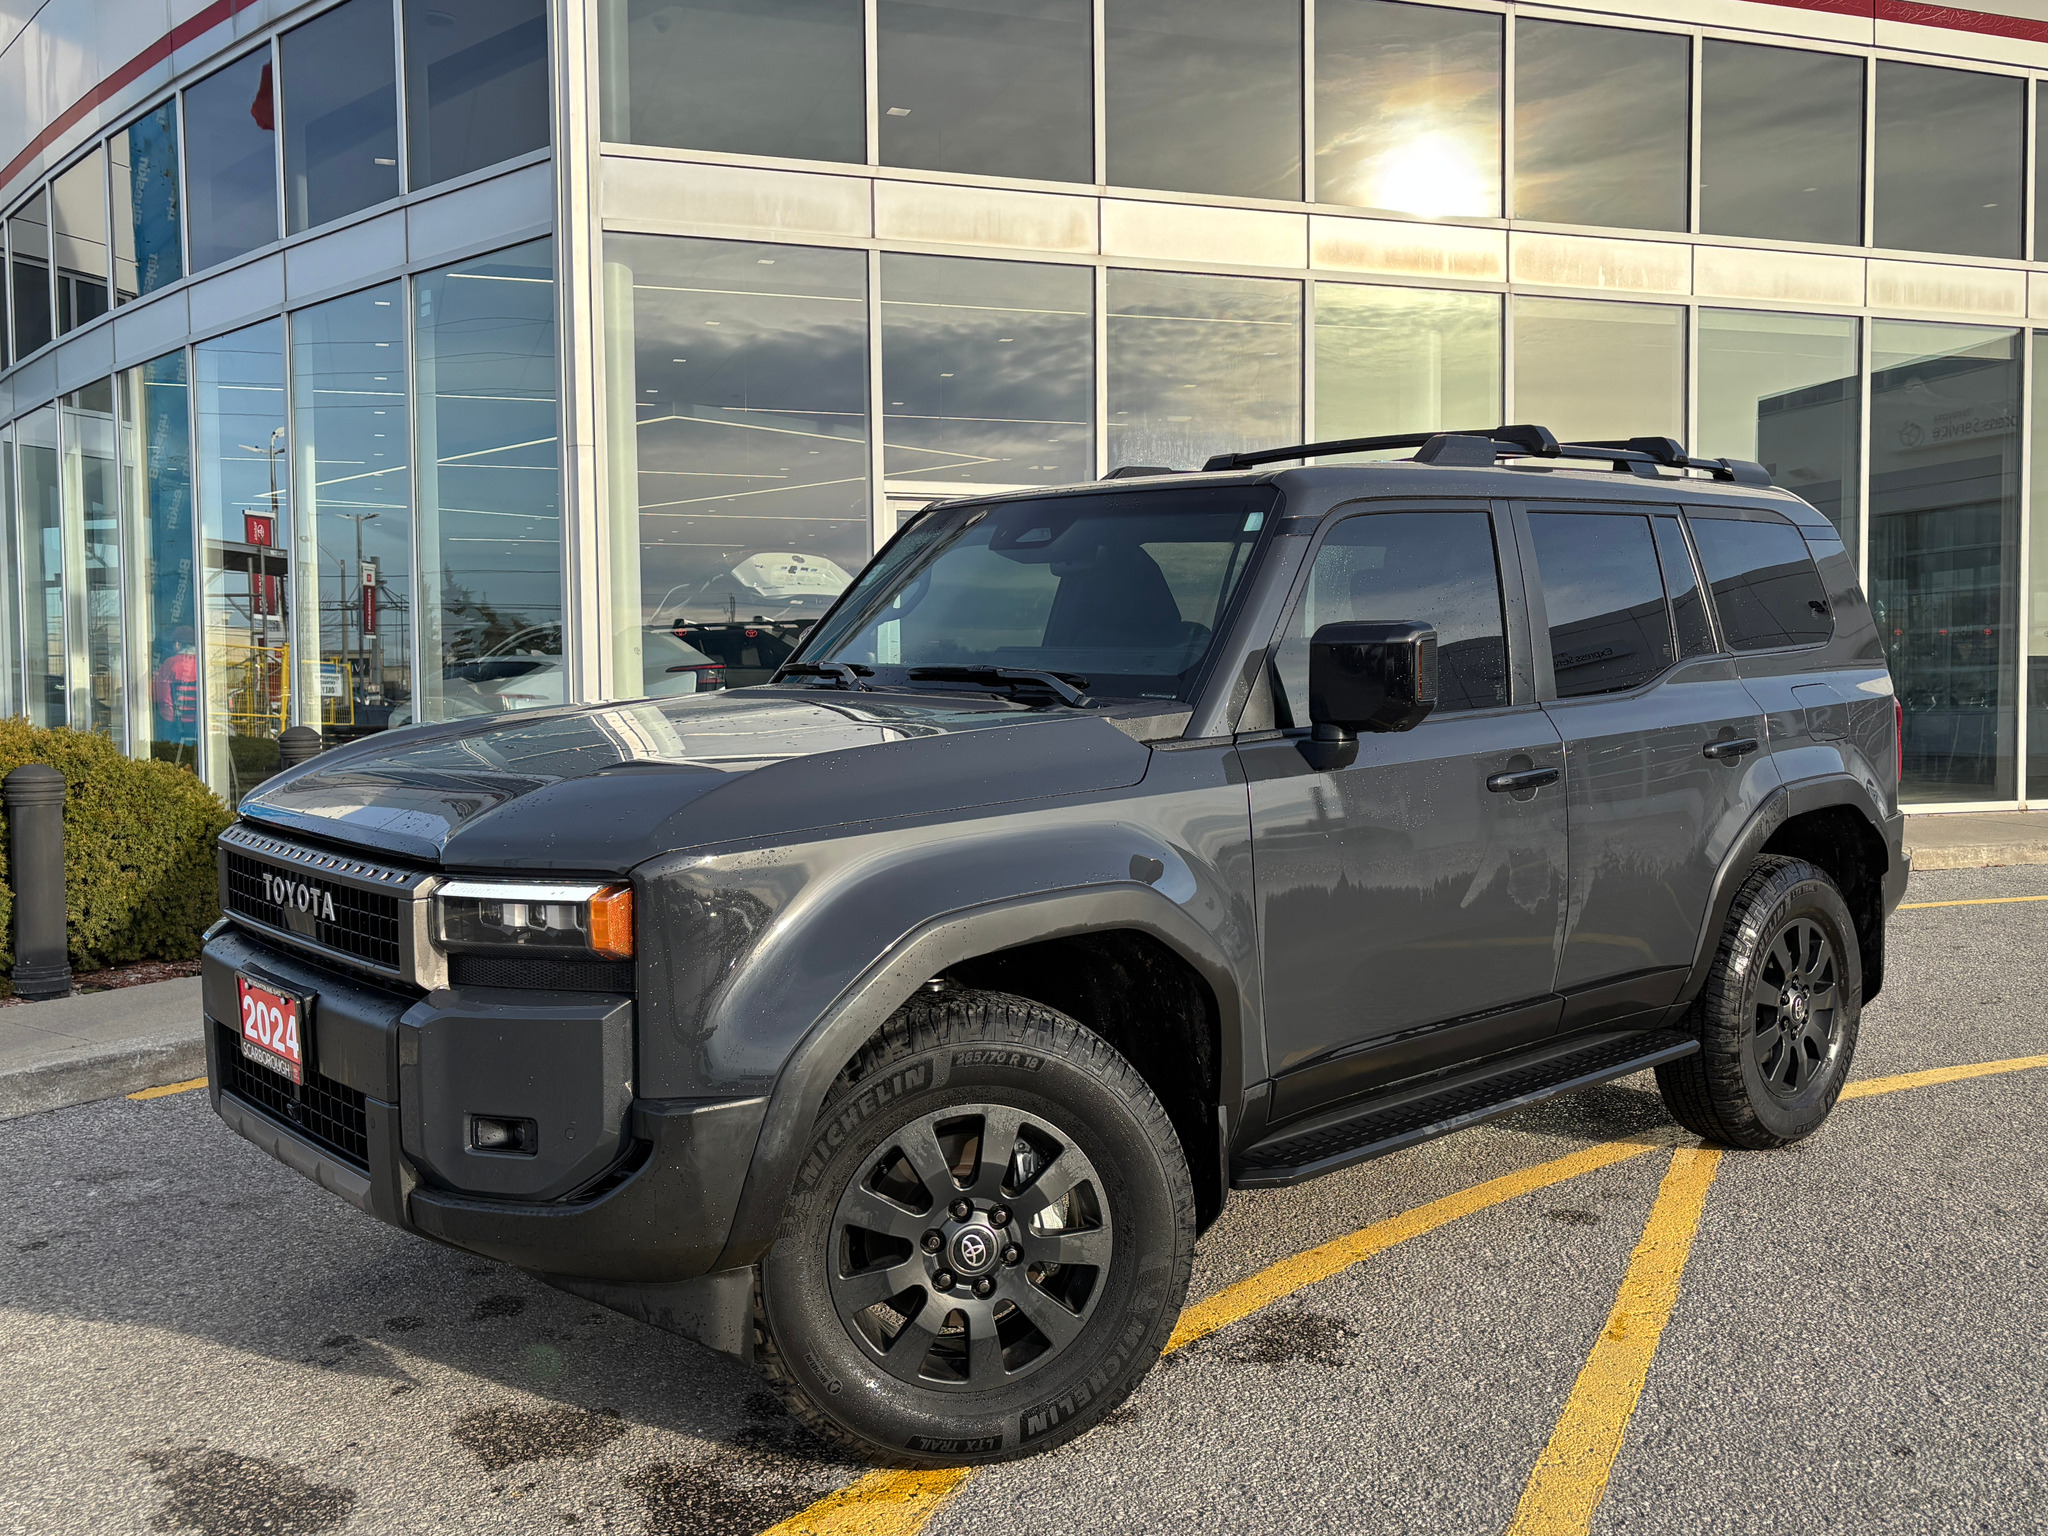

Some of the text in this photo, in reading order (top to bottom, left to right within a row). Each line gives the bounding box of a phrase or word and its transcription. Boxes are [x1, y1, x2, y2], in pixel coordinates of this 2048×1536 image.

[262, 872, 335, 921] TOYOTA
[1747, 901, 1786, 993] MICHELIN
[243, 995, 299, 1060] 2024
[242, 1041, 291, 1078] SCARBOROUGH
[956, 1051, 1038, 1069] 265/70 R 18
[800, 1065, 926, 1187] MICHELIN
[805, 1354, 829, 1384] MICHELIN
[1027, 1316, 1147, 1436] MICHELIN
[919, 1437, 995, 1451] LTX TRAIL
